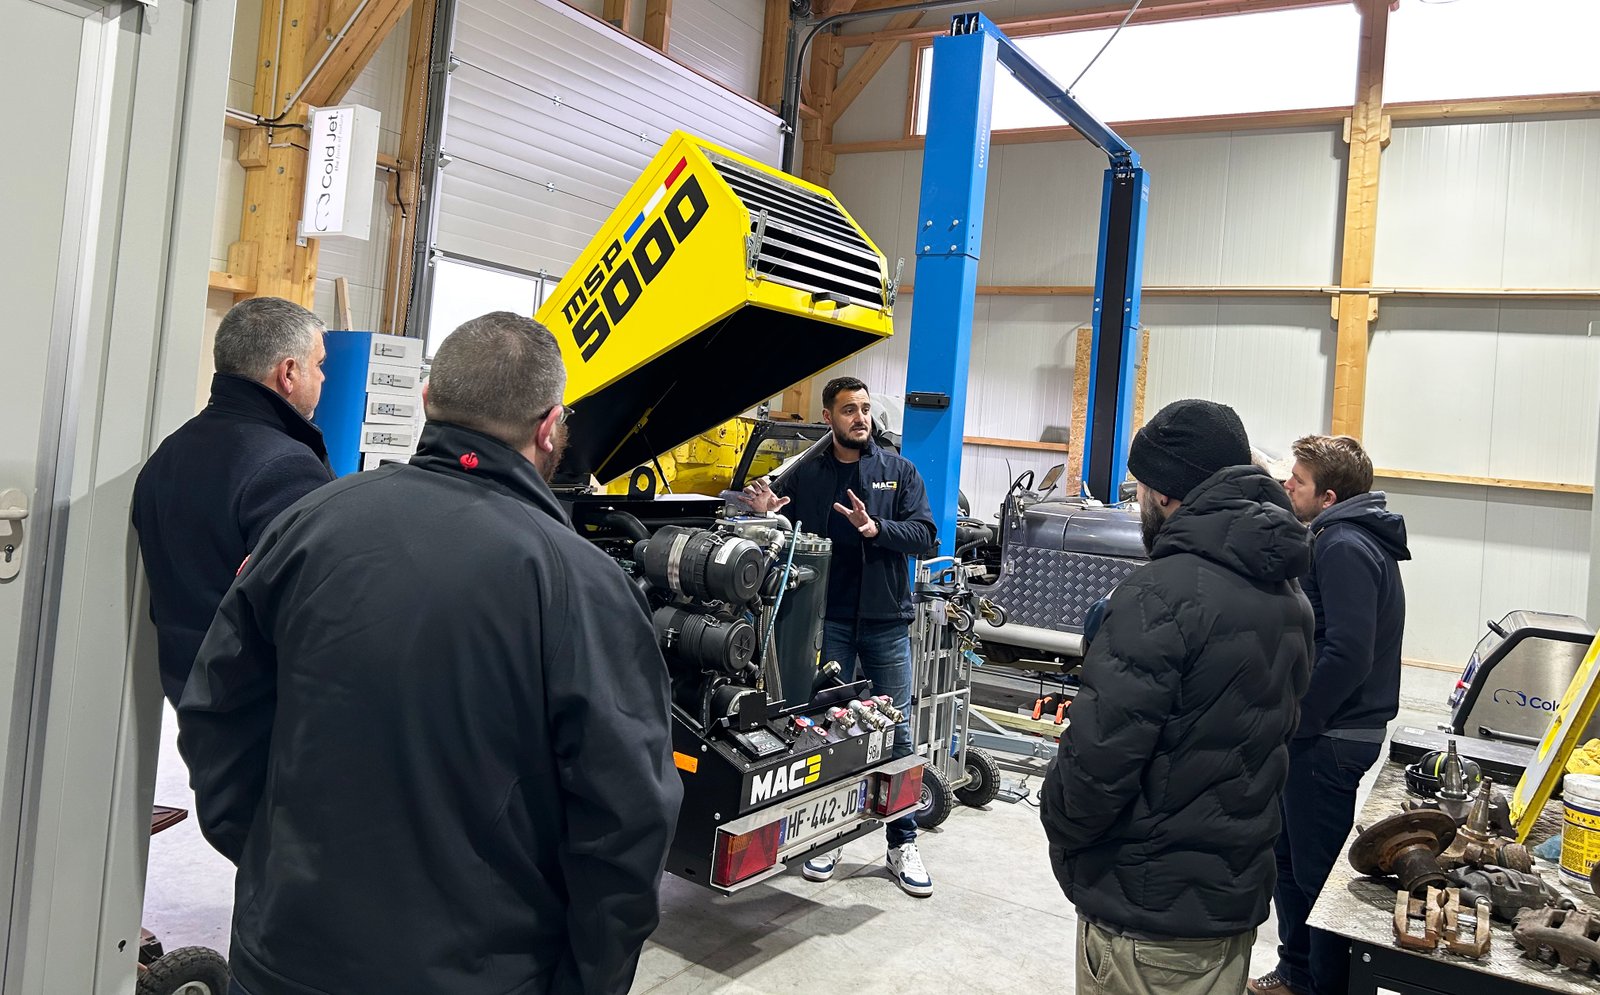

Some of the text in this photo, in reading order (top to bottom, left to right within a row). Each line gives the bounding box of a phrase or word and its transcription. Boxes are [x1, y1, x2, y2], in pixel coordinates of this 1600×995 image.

[321, 146, 335, 189] Cold
[572, 173, 709, 363] 5000
[1529, 697, 1560, 711] Col
[787, 789, 858, 840] HF-442-JD
